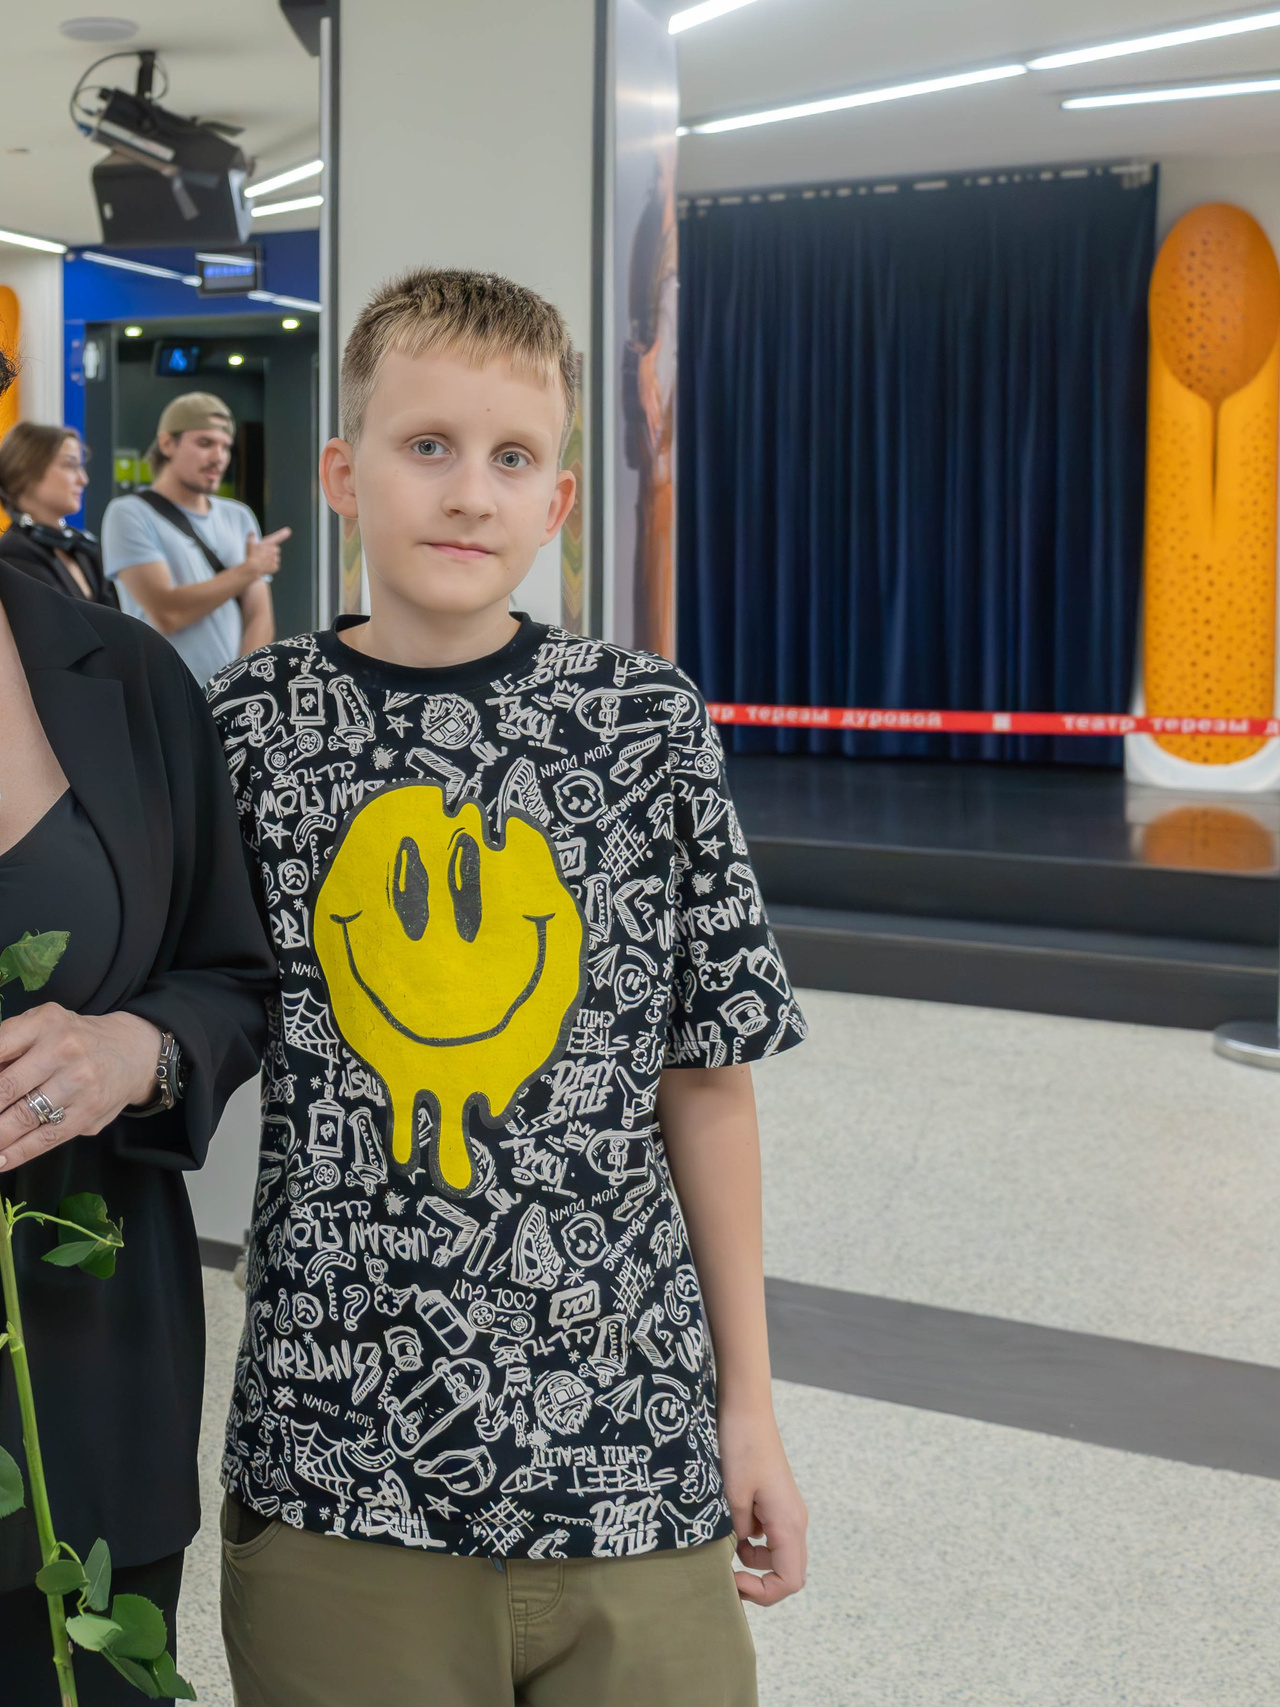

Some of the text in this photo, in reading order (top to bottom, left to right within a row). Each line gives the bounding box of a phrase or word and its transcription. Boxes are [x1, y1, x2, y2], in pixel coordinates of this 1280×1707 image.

[349, 1220, 429, 1262] URBAN
[450, 1279, 538, 1311] COOL GUY
[267, 1338, 352, 1383] URBAN
[302, 1393, 340, 1418] DOWN
